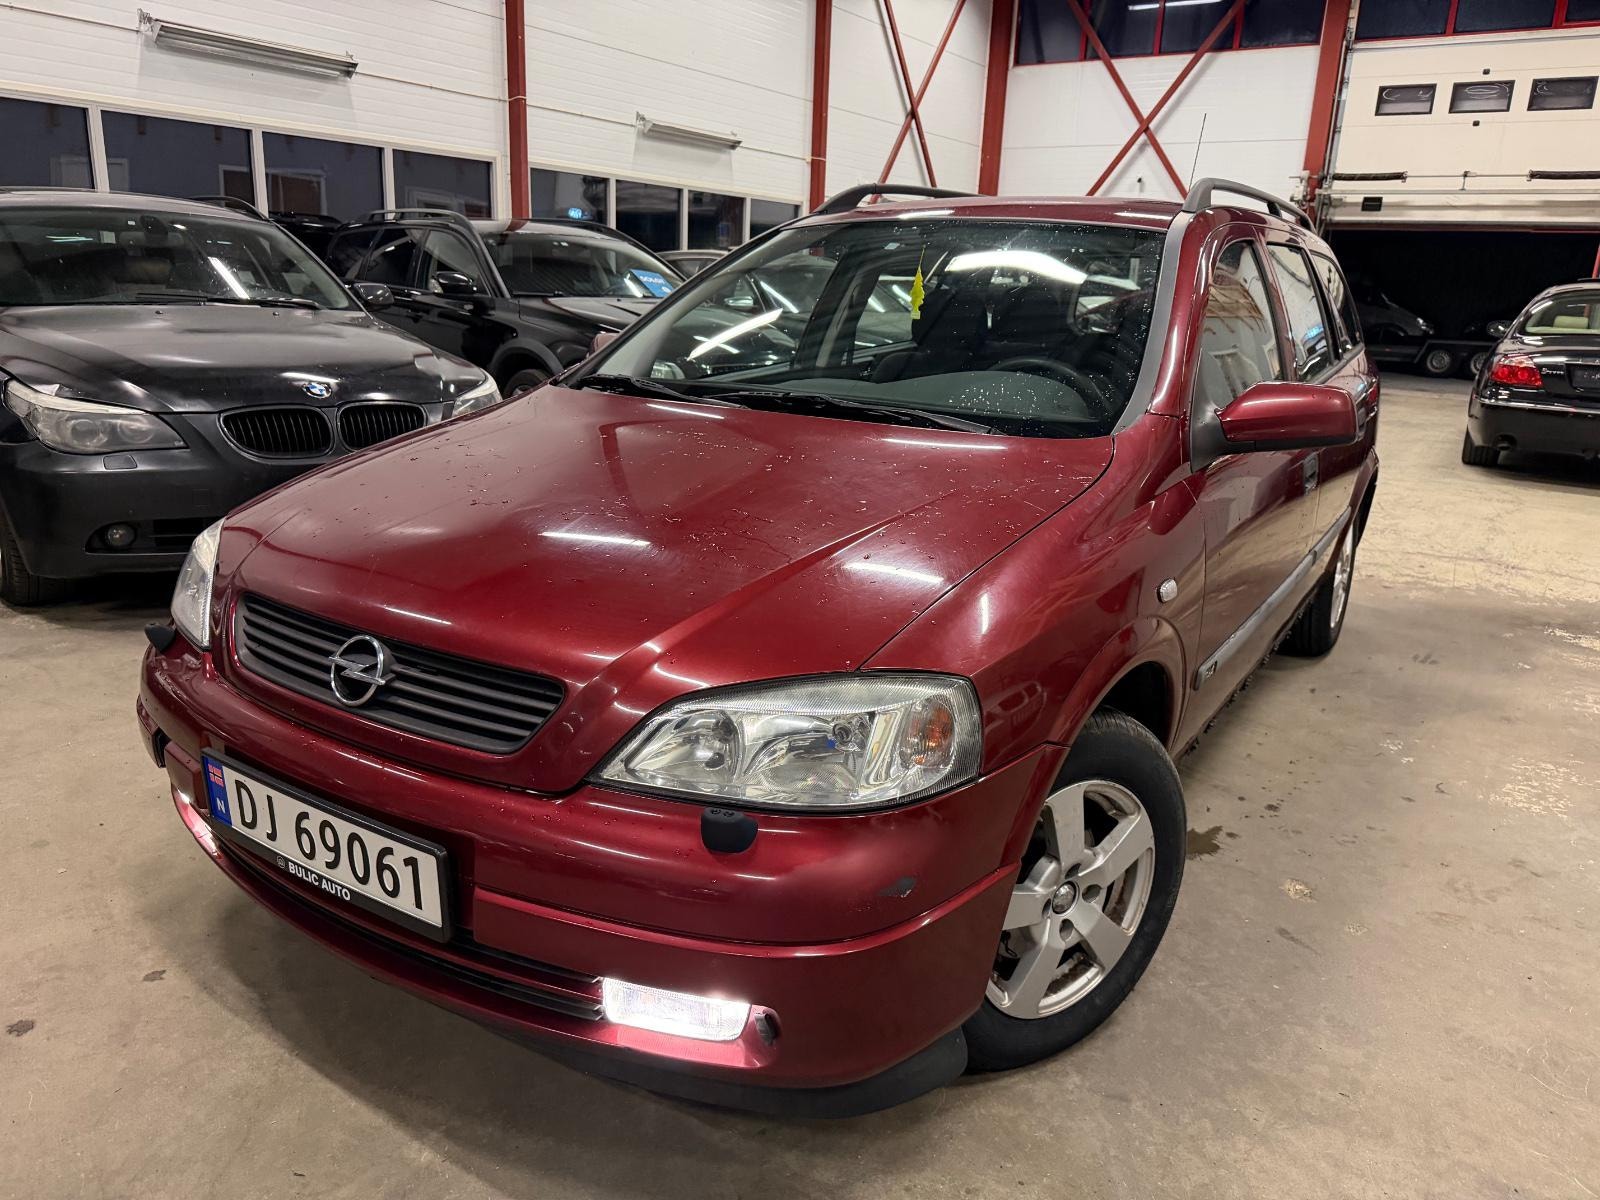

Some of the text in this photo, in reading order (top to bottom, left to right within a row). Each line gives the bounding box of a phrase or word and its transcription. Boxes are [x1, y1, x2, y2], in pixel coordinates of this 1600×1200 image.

[216, 797, 226, 814] N
[234, 779, 423, 911] DJ 69061
[288, 861, 351, 901] BULIC AUTO
